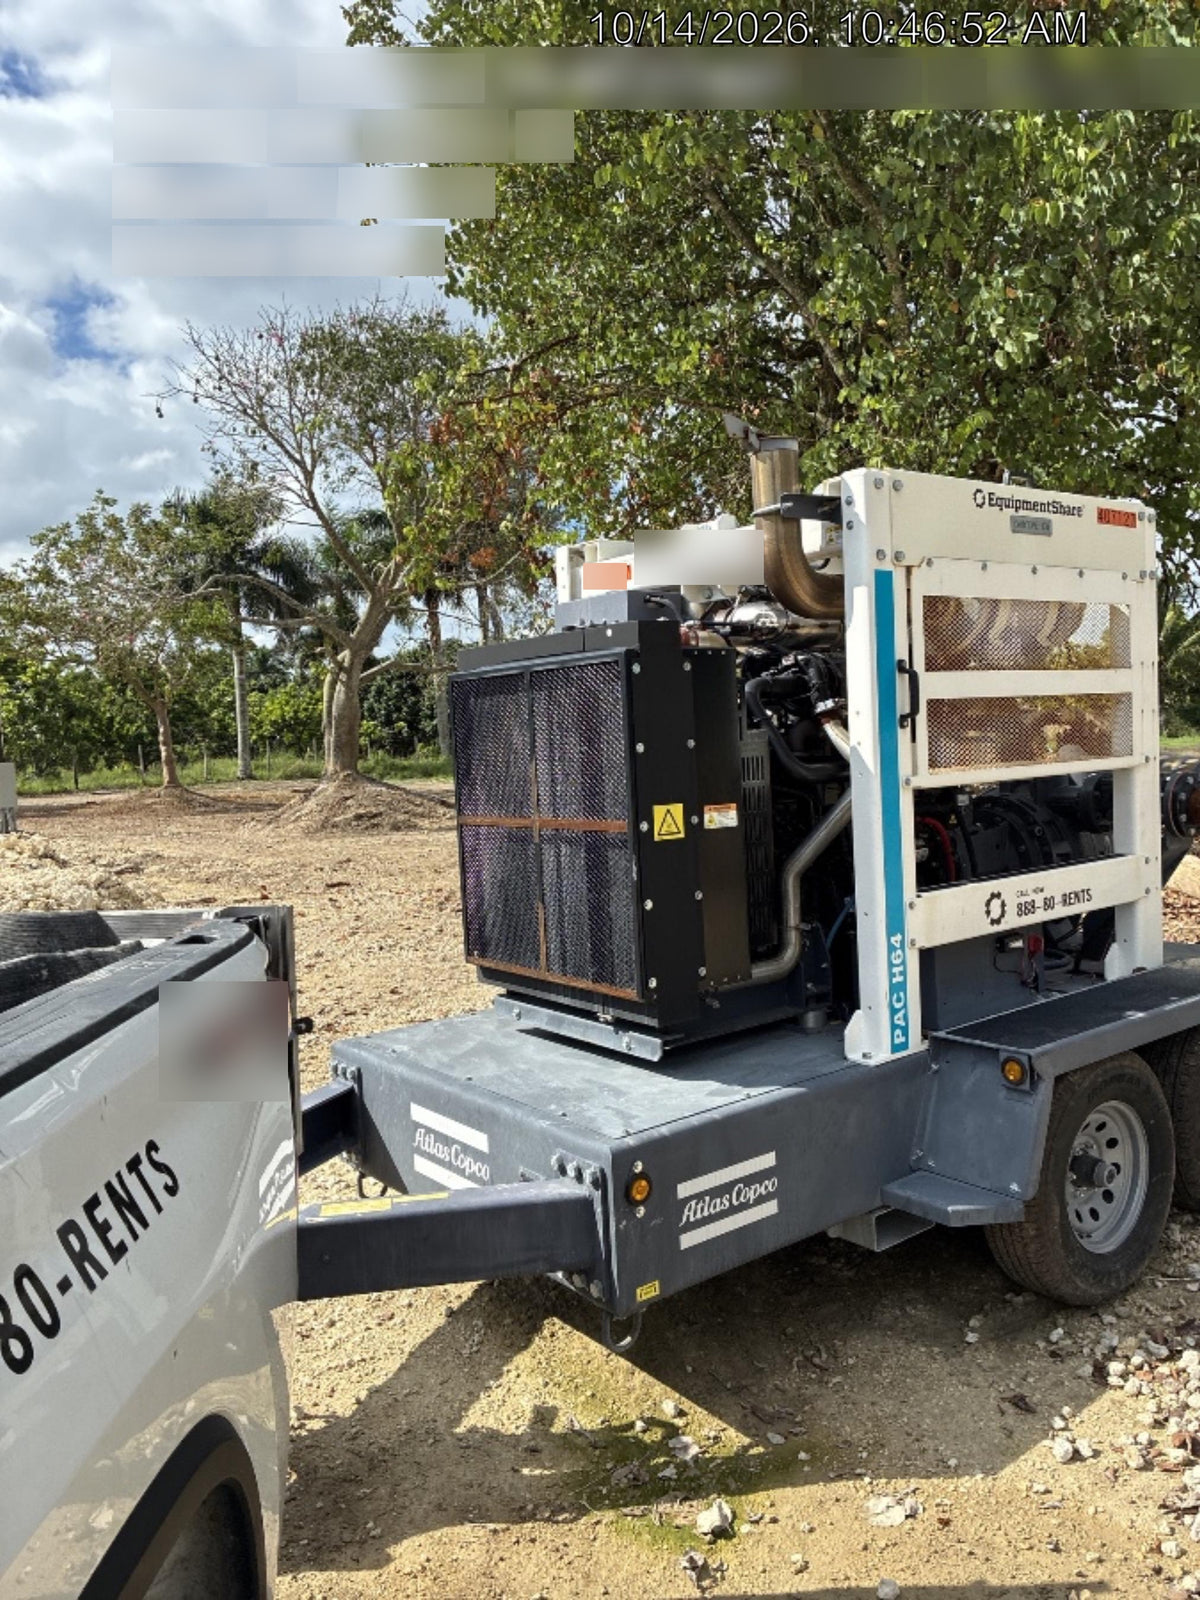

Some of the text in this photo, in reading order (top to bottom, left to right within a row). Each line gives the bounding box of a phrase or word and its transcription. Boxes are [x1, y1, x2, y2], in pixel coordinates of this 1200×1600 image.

[988, 492, 1083, 517] EquipmentShare
[890, 933, 906, 1044] PAC H64
[412, 1128, 490, 1181] Atlas Copco
[678, 1176, 778, 1227] Atlas Copco
